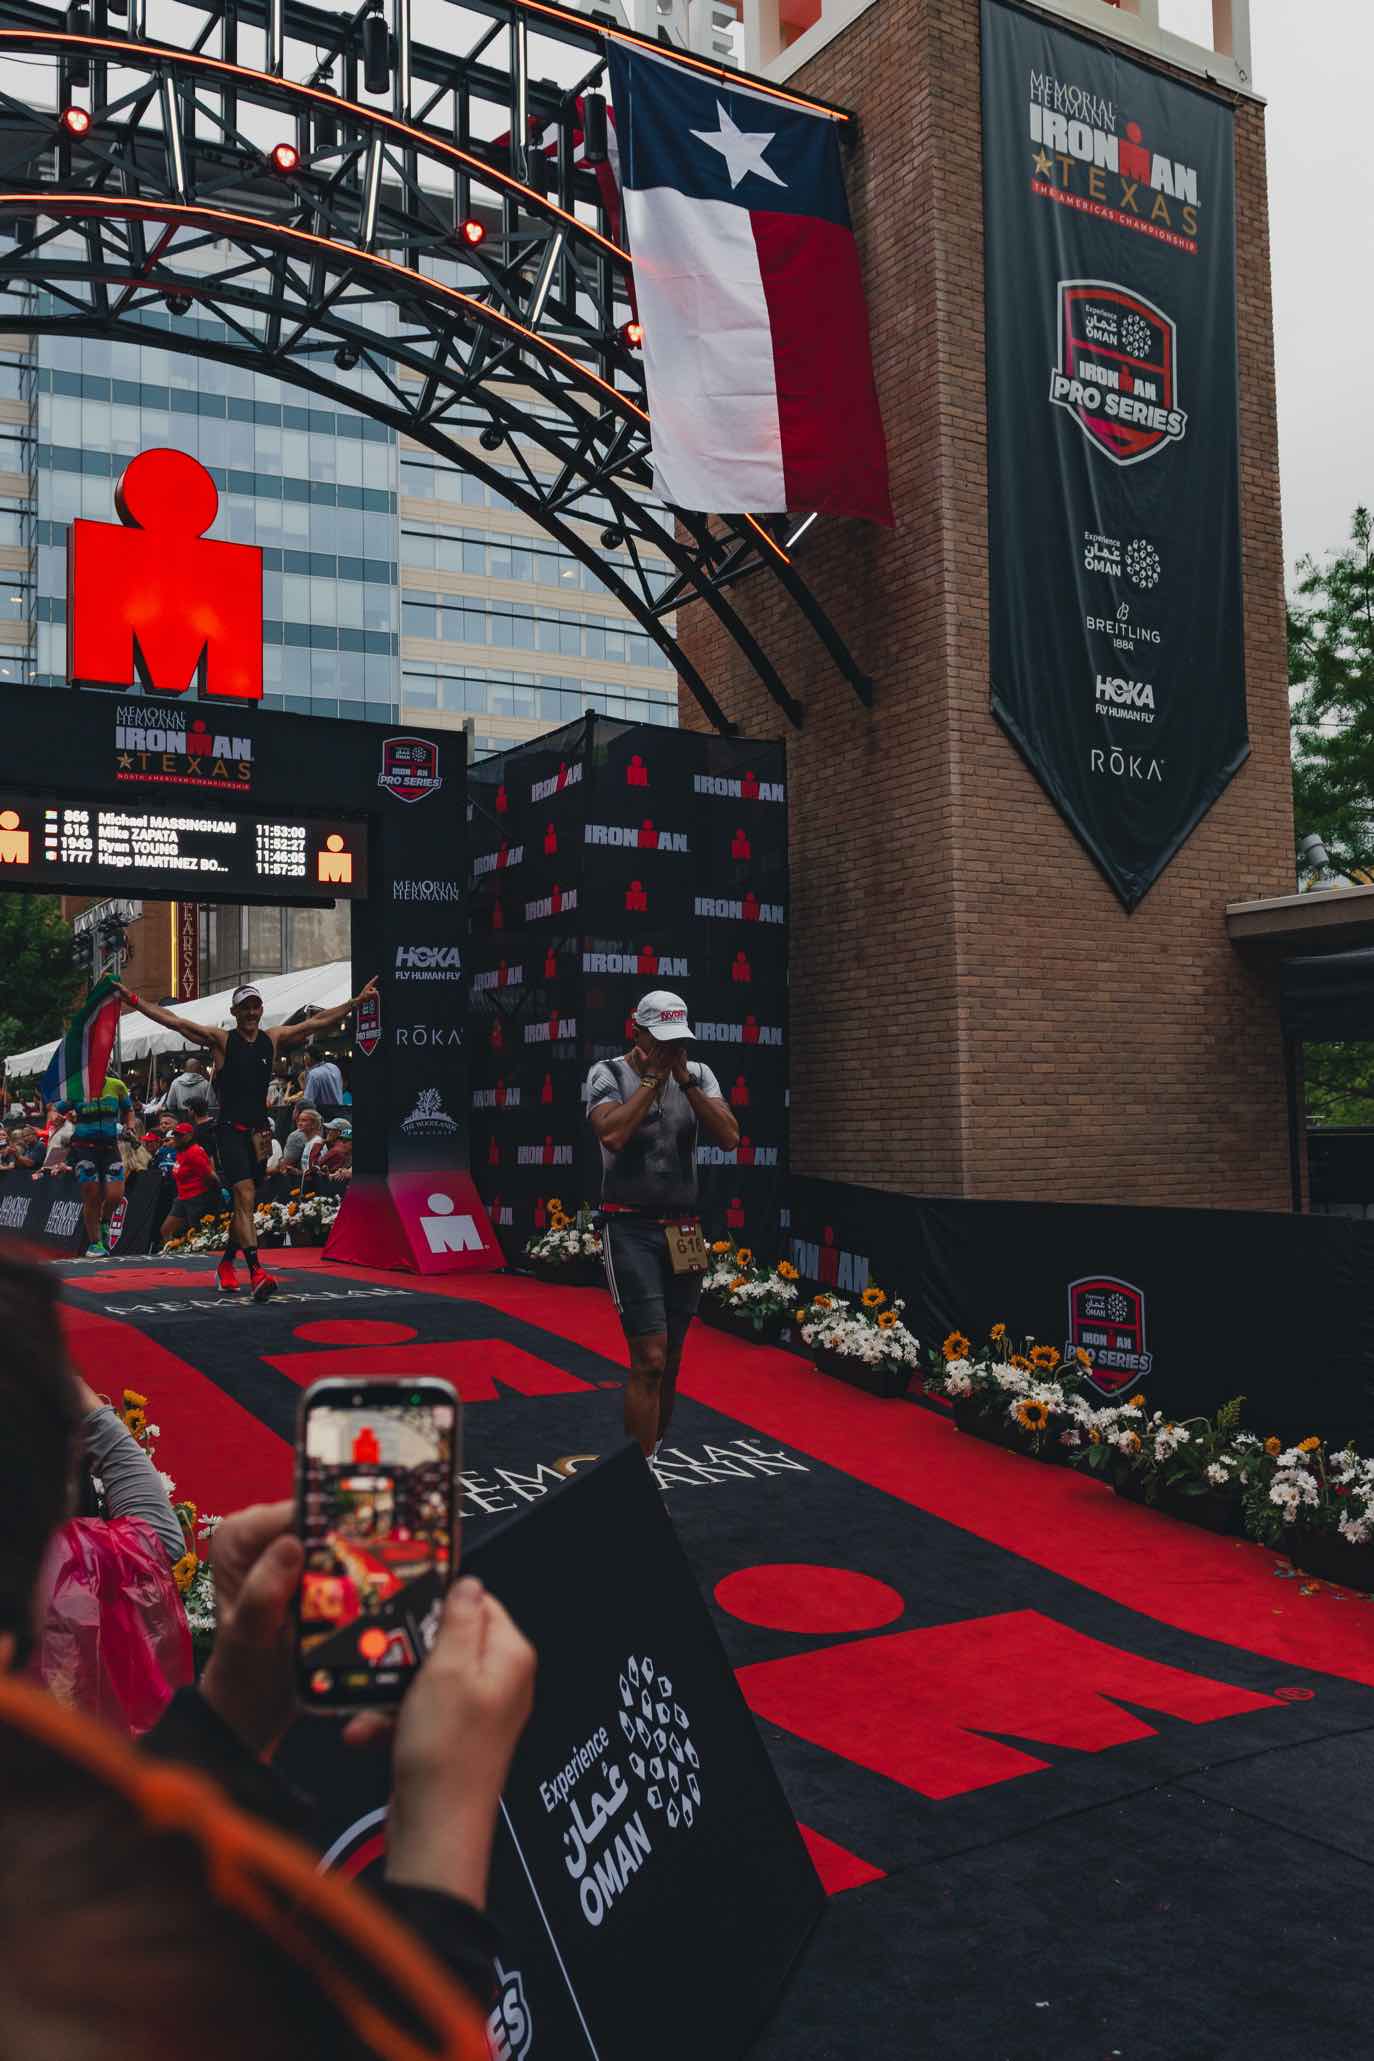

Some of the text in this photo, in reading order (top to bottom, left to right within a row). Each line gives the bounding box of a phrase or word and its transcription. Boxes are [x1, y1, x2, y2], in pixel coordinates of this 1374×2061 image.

[1030, 69, 1117, 118] MEMORIAL
[1030, 86, 1117, 131] HERMANN
[1030, 102, 1200, 208] IRONMAN
[1055, 153, 1198, 236] TEXAS
[1058, 192, 1116, 220] AMERICAS
[1119, 213, 1197, 251] CHAMPIONSHIP
[1085, 303, 1119, 320] Experience
[1086, 327, 1119, 346] OMAN
[1079, 360, 1157, 401] IRONMAN
[1054, 376, 1182, 435] PRO SERIES
[1084, 531, 1121, 548] Experience
[1084, 557, 1121, 577] OMAN
[1086, 616, 1161, 644] BREITLING
[1112, 638, 1134, 651] 1884
[1095, 674, 1155, 709] HOKA
[116, 705, 185, 721] MEMORIAL
[116, 715, 186, 730] HERMANN
[1095, 703, 1155, 723] FLY HUMAN FLY
[115, 720, 253, 761] IRONMAN
[136, 752, 251, 780] TEXAS
[380, 775, 440, 787] PRO SERIES
[531, 760, 584, 803] IRONMAN
[694, 769, 784, 803] IRONMAN
[98, 812, 148, 827] Michael
[150, 816, 236, 833] MASSINGHAM
[256, 825, 305, 838] 11:53:00
[98, 826, 129, 839] Mike
[132, 828, 178, 842] ZAPATA
[256, 837, 305, 850] 11:52:27
[585, 818, 691, 853] IRONMAN
[98, 839, 129, 853] Ryan
[132, 841, 178, 855] YOUNG
[61, 850, 92, 863] 1777
[98, 853, 132, 867] Hugo
[134, 855, 198, 869] MARTINEZ
[256, 863, 305, 875] 11:57:20
[393, 880, 457, 898] MEMORIAL
[393, 887, 459, 901] HERMANN
[694, 890, 784, 925] IRONMAN
[181, 902, 195, 998] EARSAY
[395, 946, 461, 968] HOKA
[582, 944, 689, 977] IRONMAN
[395, 970, 461, 982] FLY HUMAN FLY
[694, 1014, 783, 1046] IRONMAN
[1067, 1345, 1148, 1371] PO SERIES
[539, 1726, 610, 1813] Experience
[579, 1810, 652, 1927] OMAN
